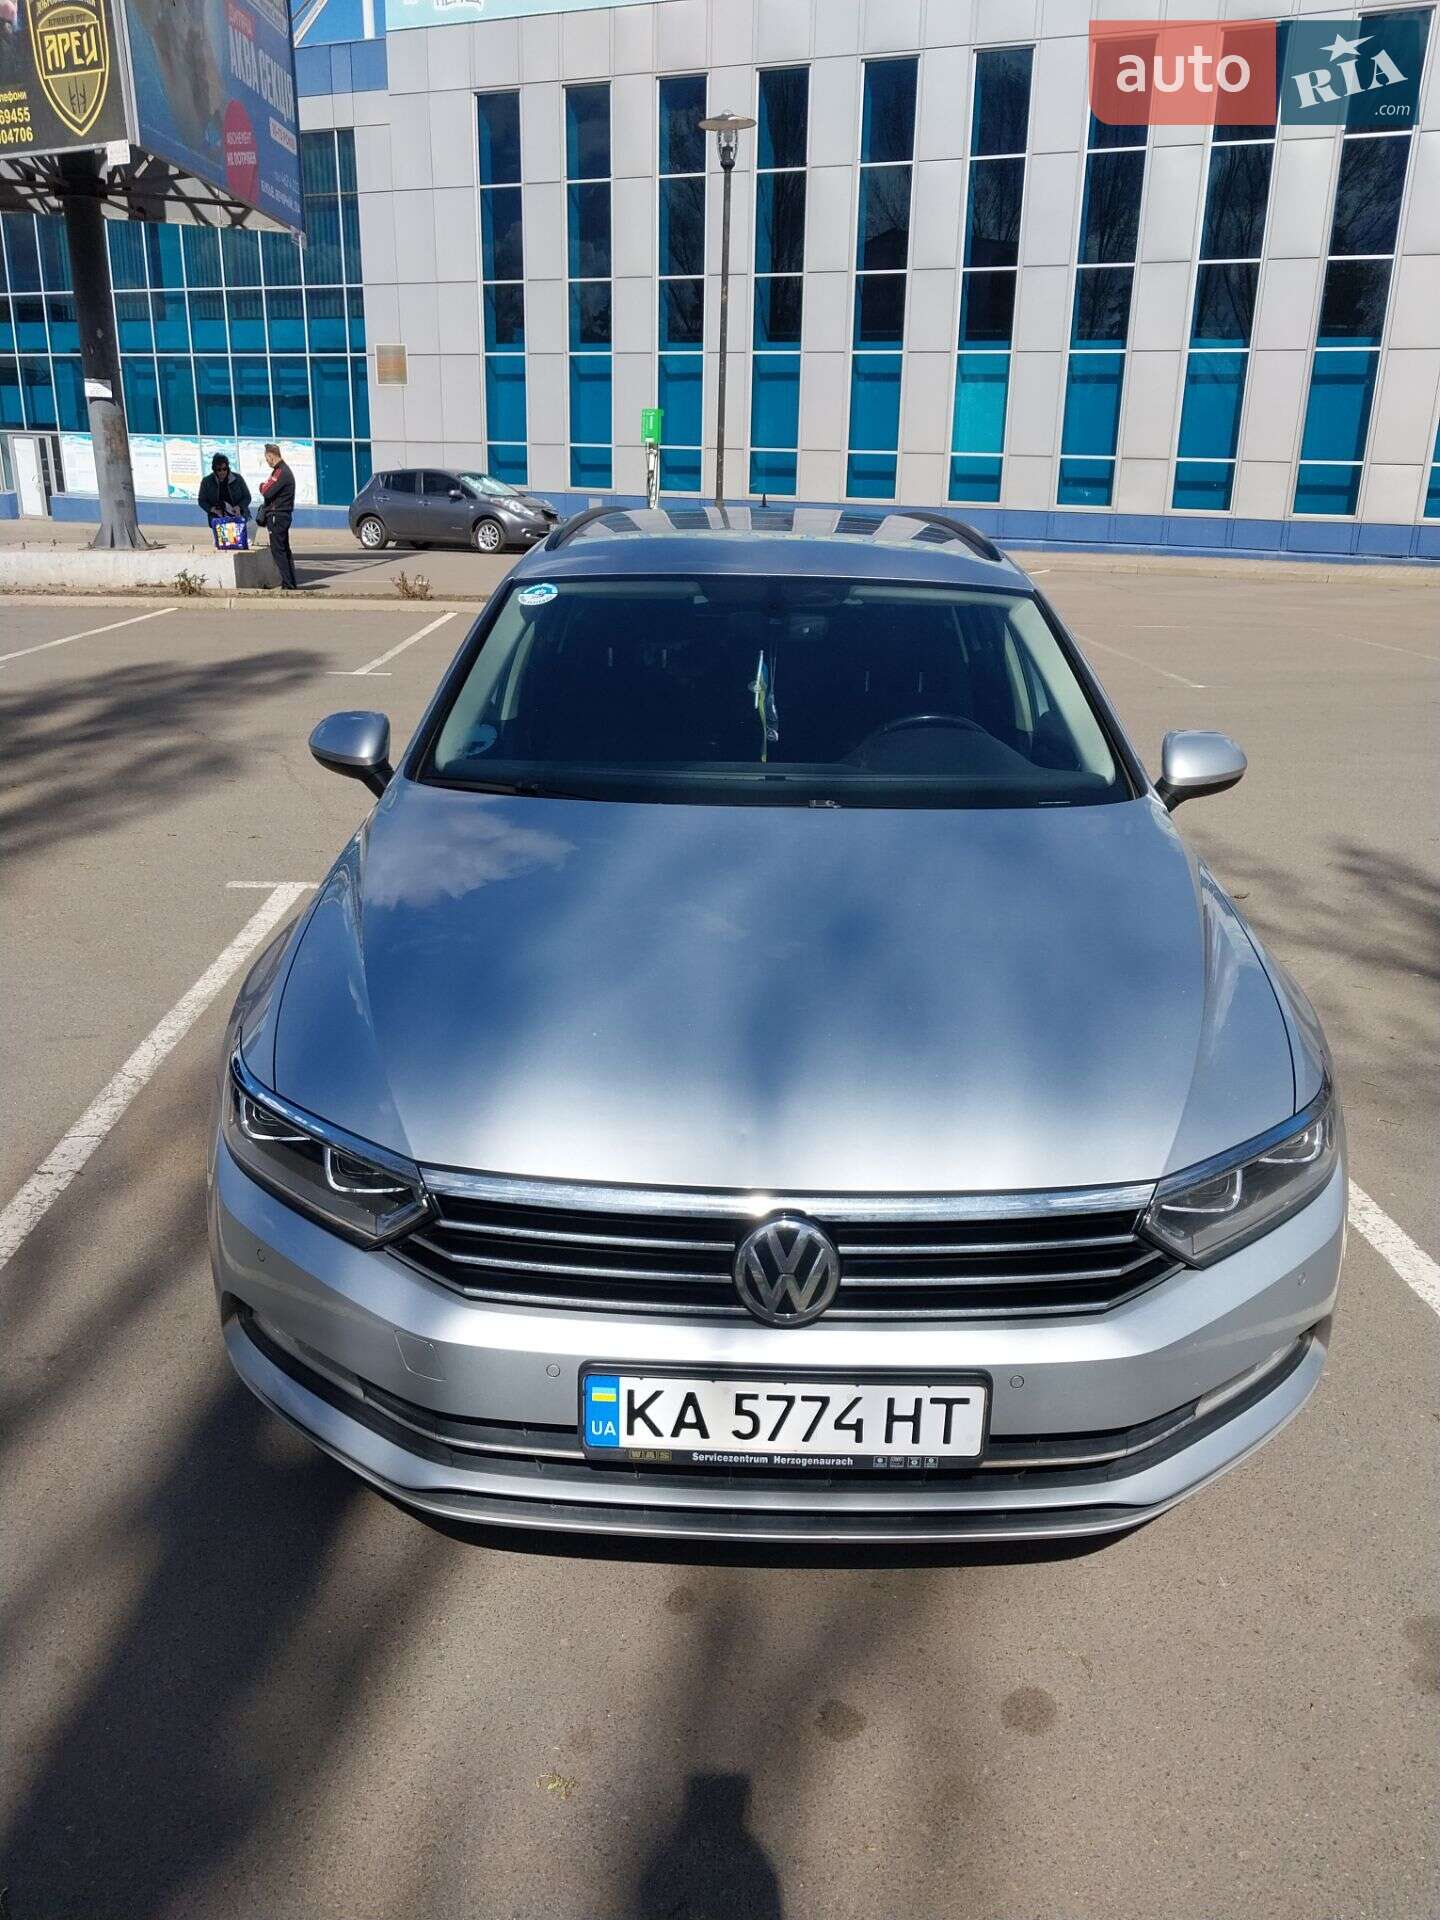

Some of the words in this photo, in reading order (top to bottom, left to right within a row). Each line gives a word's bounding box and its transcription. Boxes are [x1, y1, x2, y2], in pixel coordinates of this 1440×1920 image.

[0, 127, 33, 144] 04706
[626, 1389, 710, 1440] KA
[731, 1393, 864, 1444] 5774
[885, 1397, 971, 1445] HT
[592, 1420, 616, 1436] UA
[692, 1452, 768, 1464] Servicezentrum
[773, 1455, 853, 1467] Herzogenaurach
